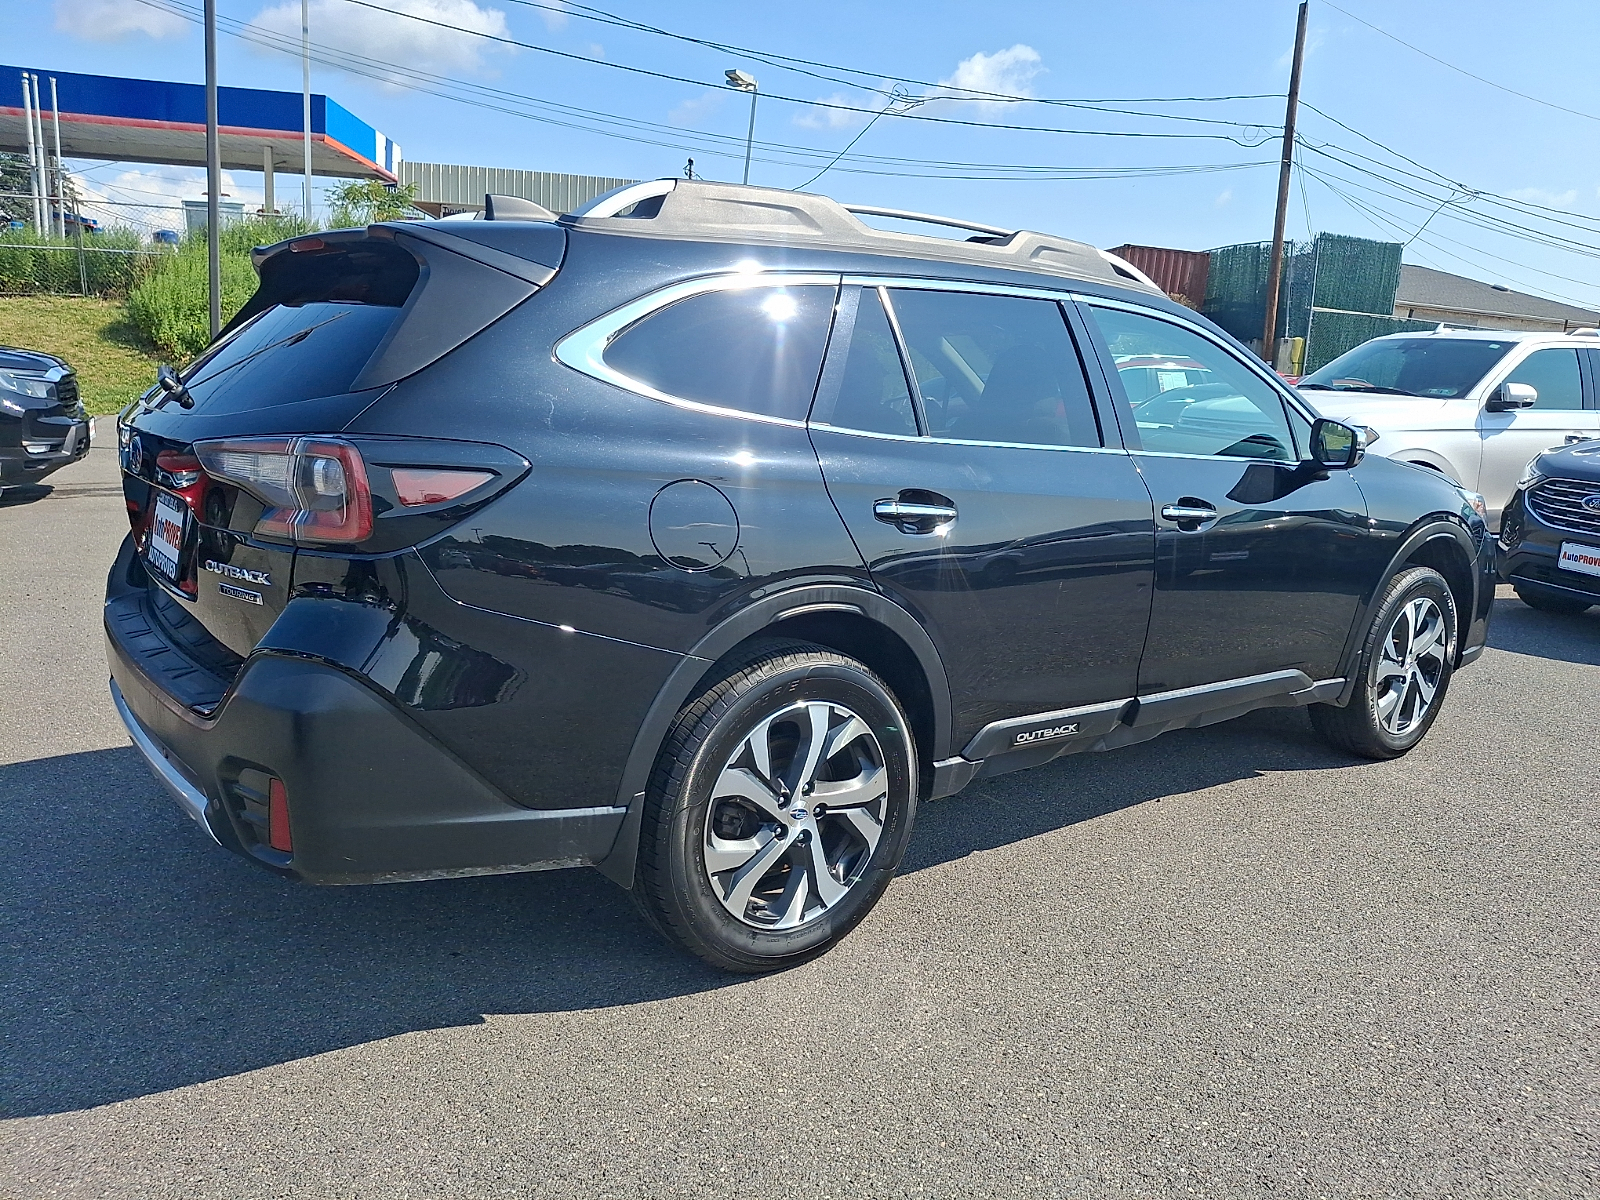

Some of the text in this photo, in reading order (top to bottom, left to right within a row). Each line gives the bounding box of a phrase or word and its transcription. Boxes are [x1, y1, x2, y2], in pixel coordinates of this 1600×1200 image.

[1562, 551, 1600, 567] AutoPROVE
[204, 560, 271, 586] OUTBACK
[222, 587, 255, 601] TOURING
[1016, 723, 1078, 742] OUTBACK
